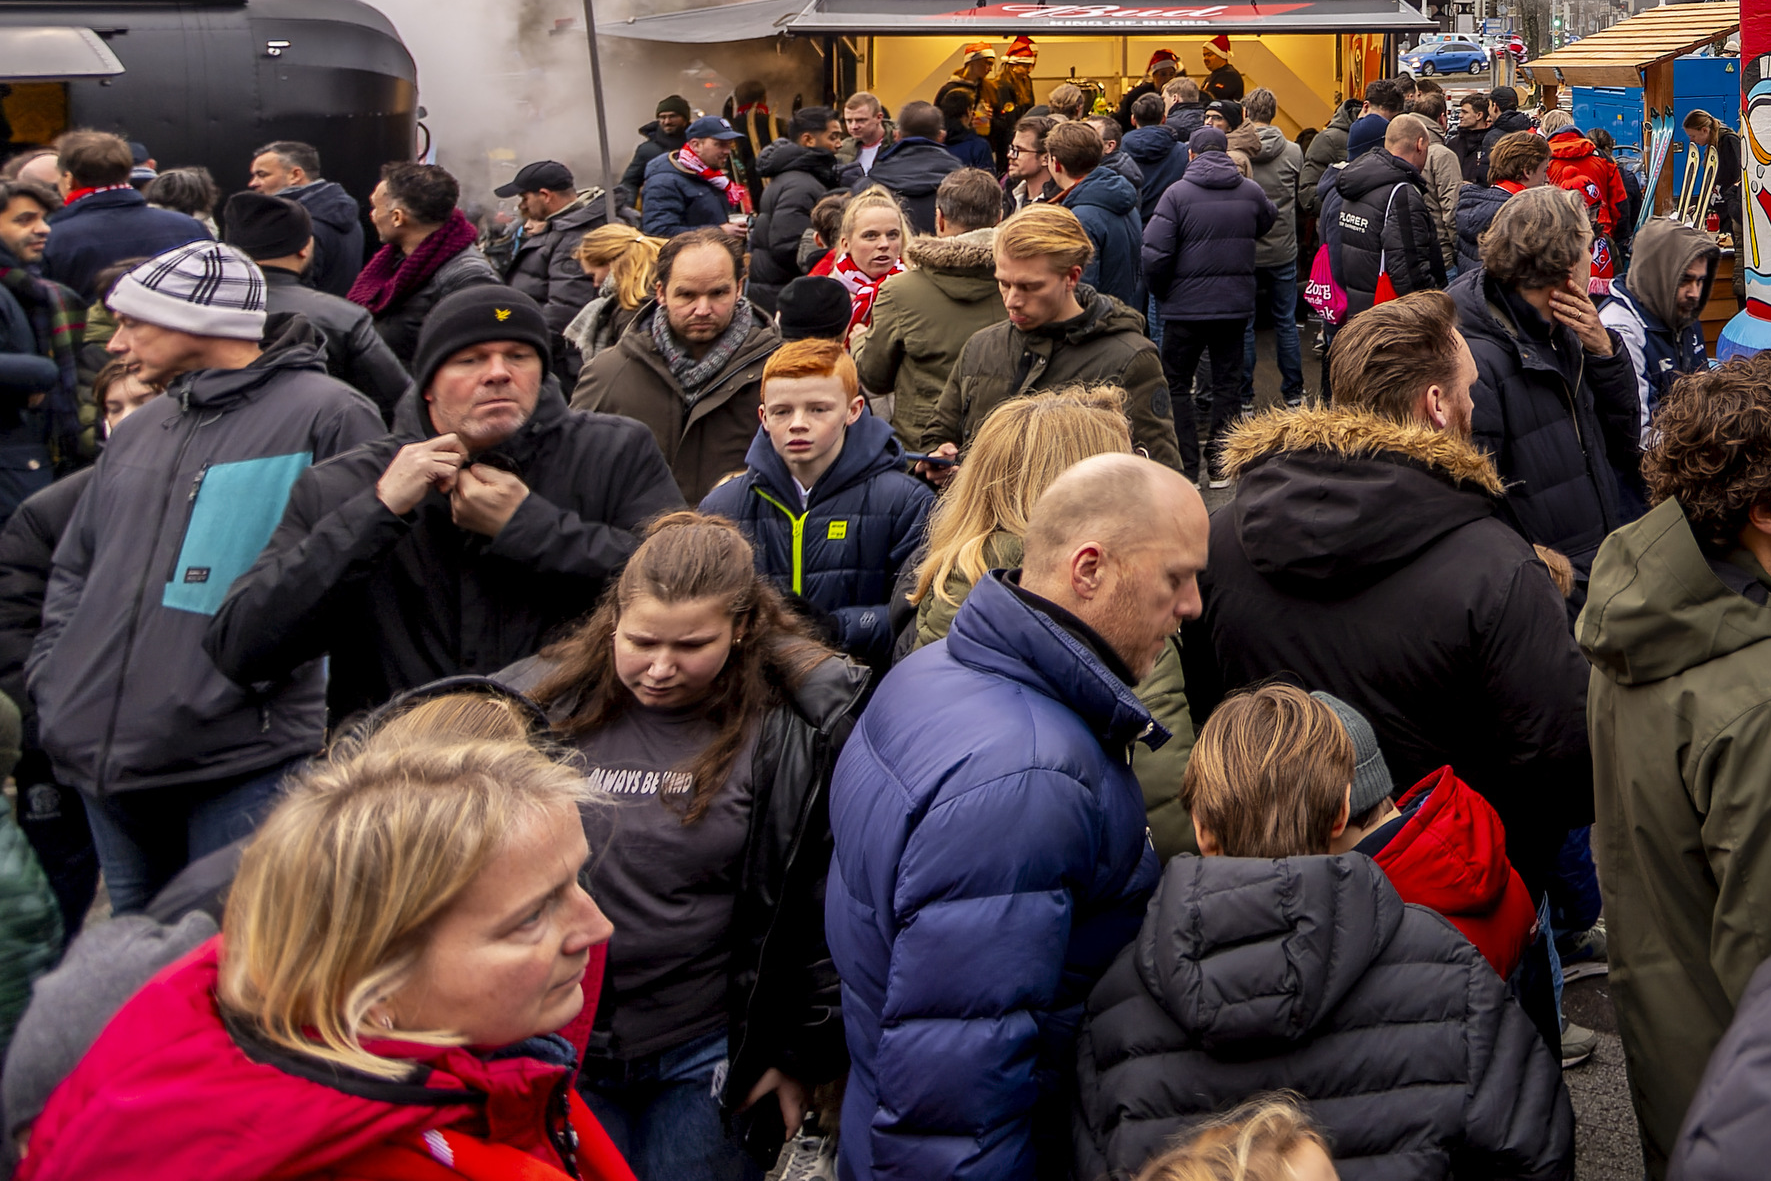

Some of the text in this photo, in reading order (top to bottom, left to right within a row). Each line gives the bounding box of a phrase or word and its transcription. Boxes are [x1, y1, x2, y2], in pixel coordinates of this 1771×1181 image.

[1002, 4, 1229, 18] Bud
[1305, 279, 1331, 300] Zorg
[587, 767, 642, 794] ALWAYS
[640, 771, 660, 795] BE
